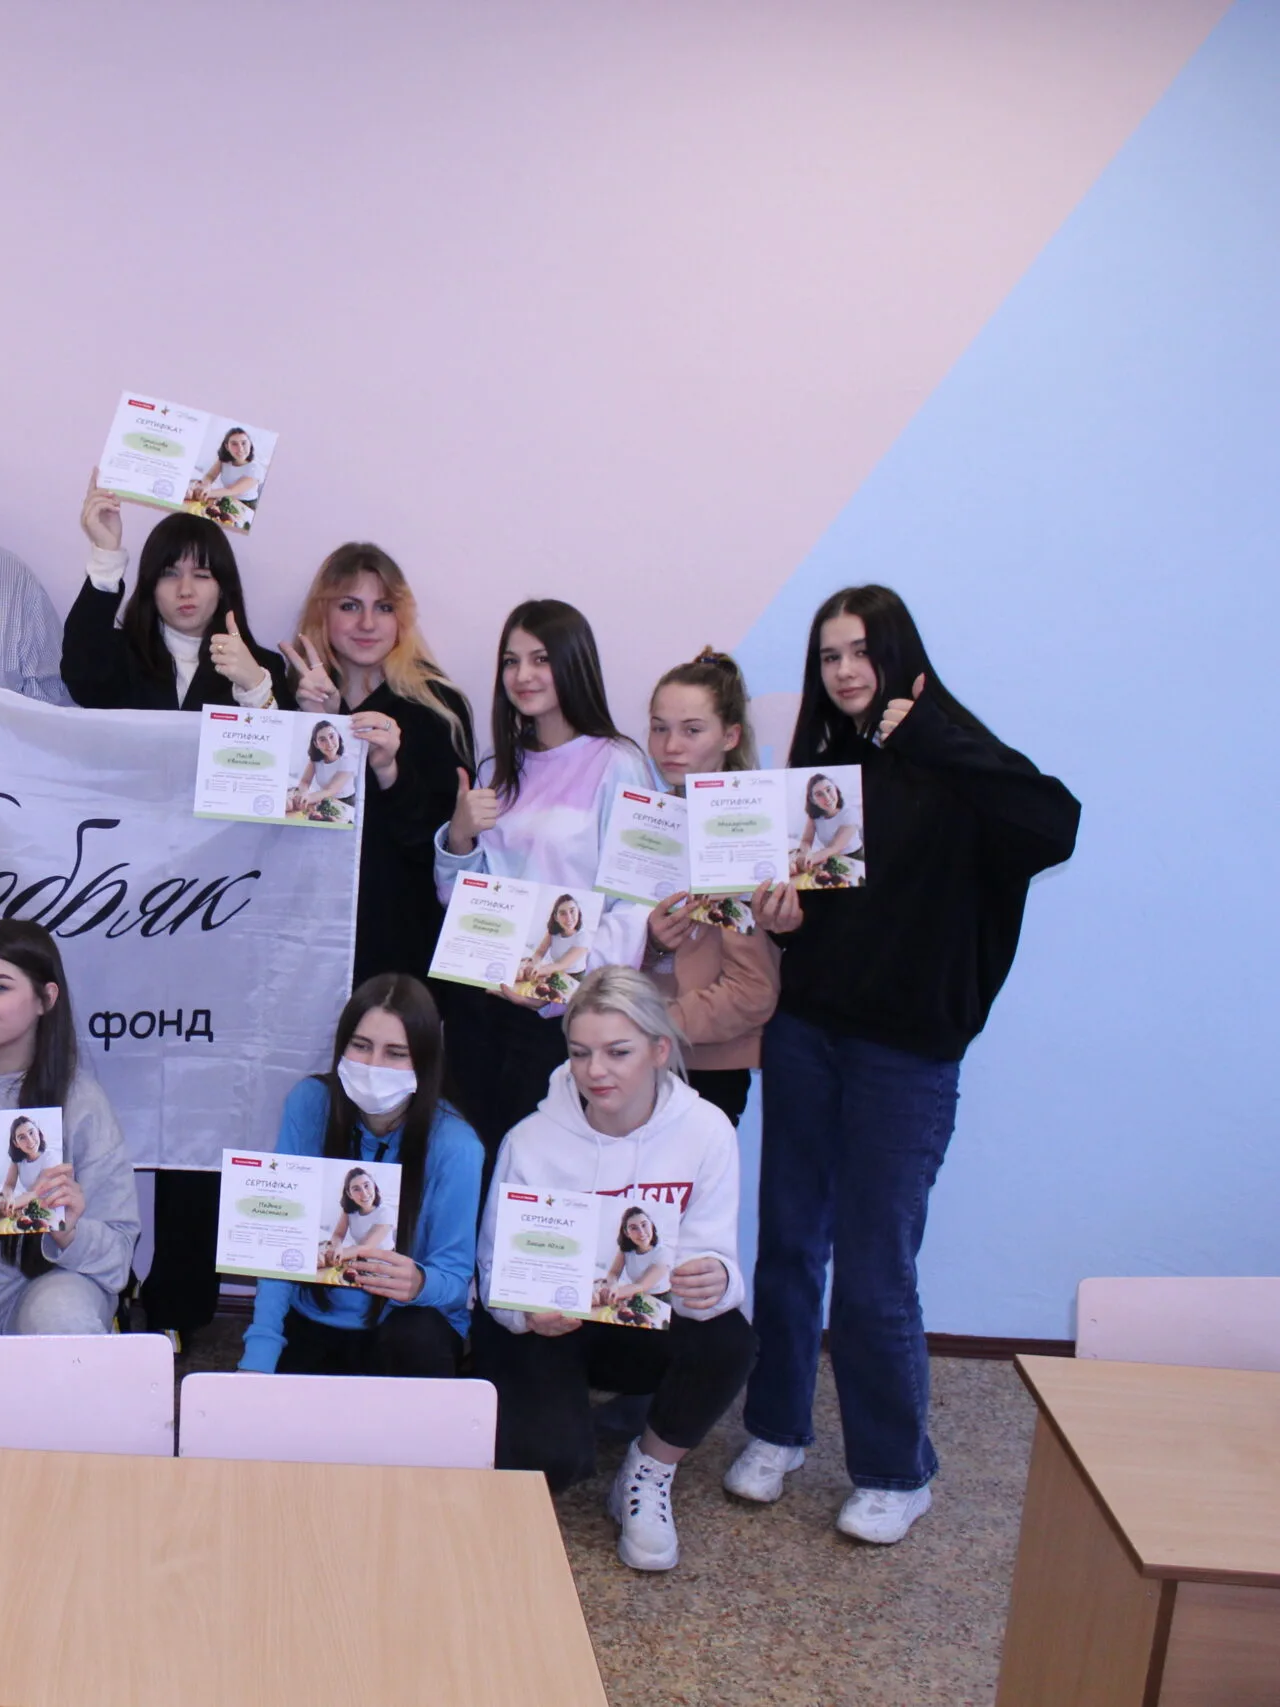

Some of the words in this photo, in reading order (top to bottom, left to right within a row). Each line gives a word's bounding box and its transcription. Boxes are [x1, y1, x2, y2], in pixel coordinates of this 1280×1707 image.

[135, 417, 184, 434] СЕРТИФІКАТ
[222, 731, 271, 742] СЕРТИФІКАТ
[632, 812, 682, 831] СЕРТИФІКАТ
[470, 897, 515, 911] СЕРТИФІКАТ
[88, 1008, 214, 1052] фонд
[245, 1178, 298, 1190] СЕРТИФІКАТ
[521, 1214, 576, 1227] СЕРТИФІКАТ
